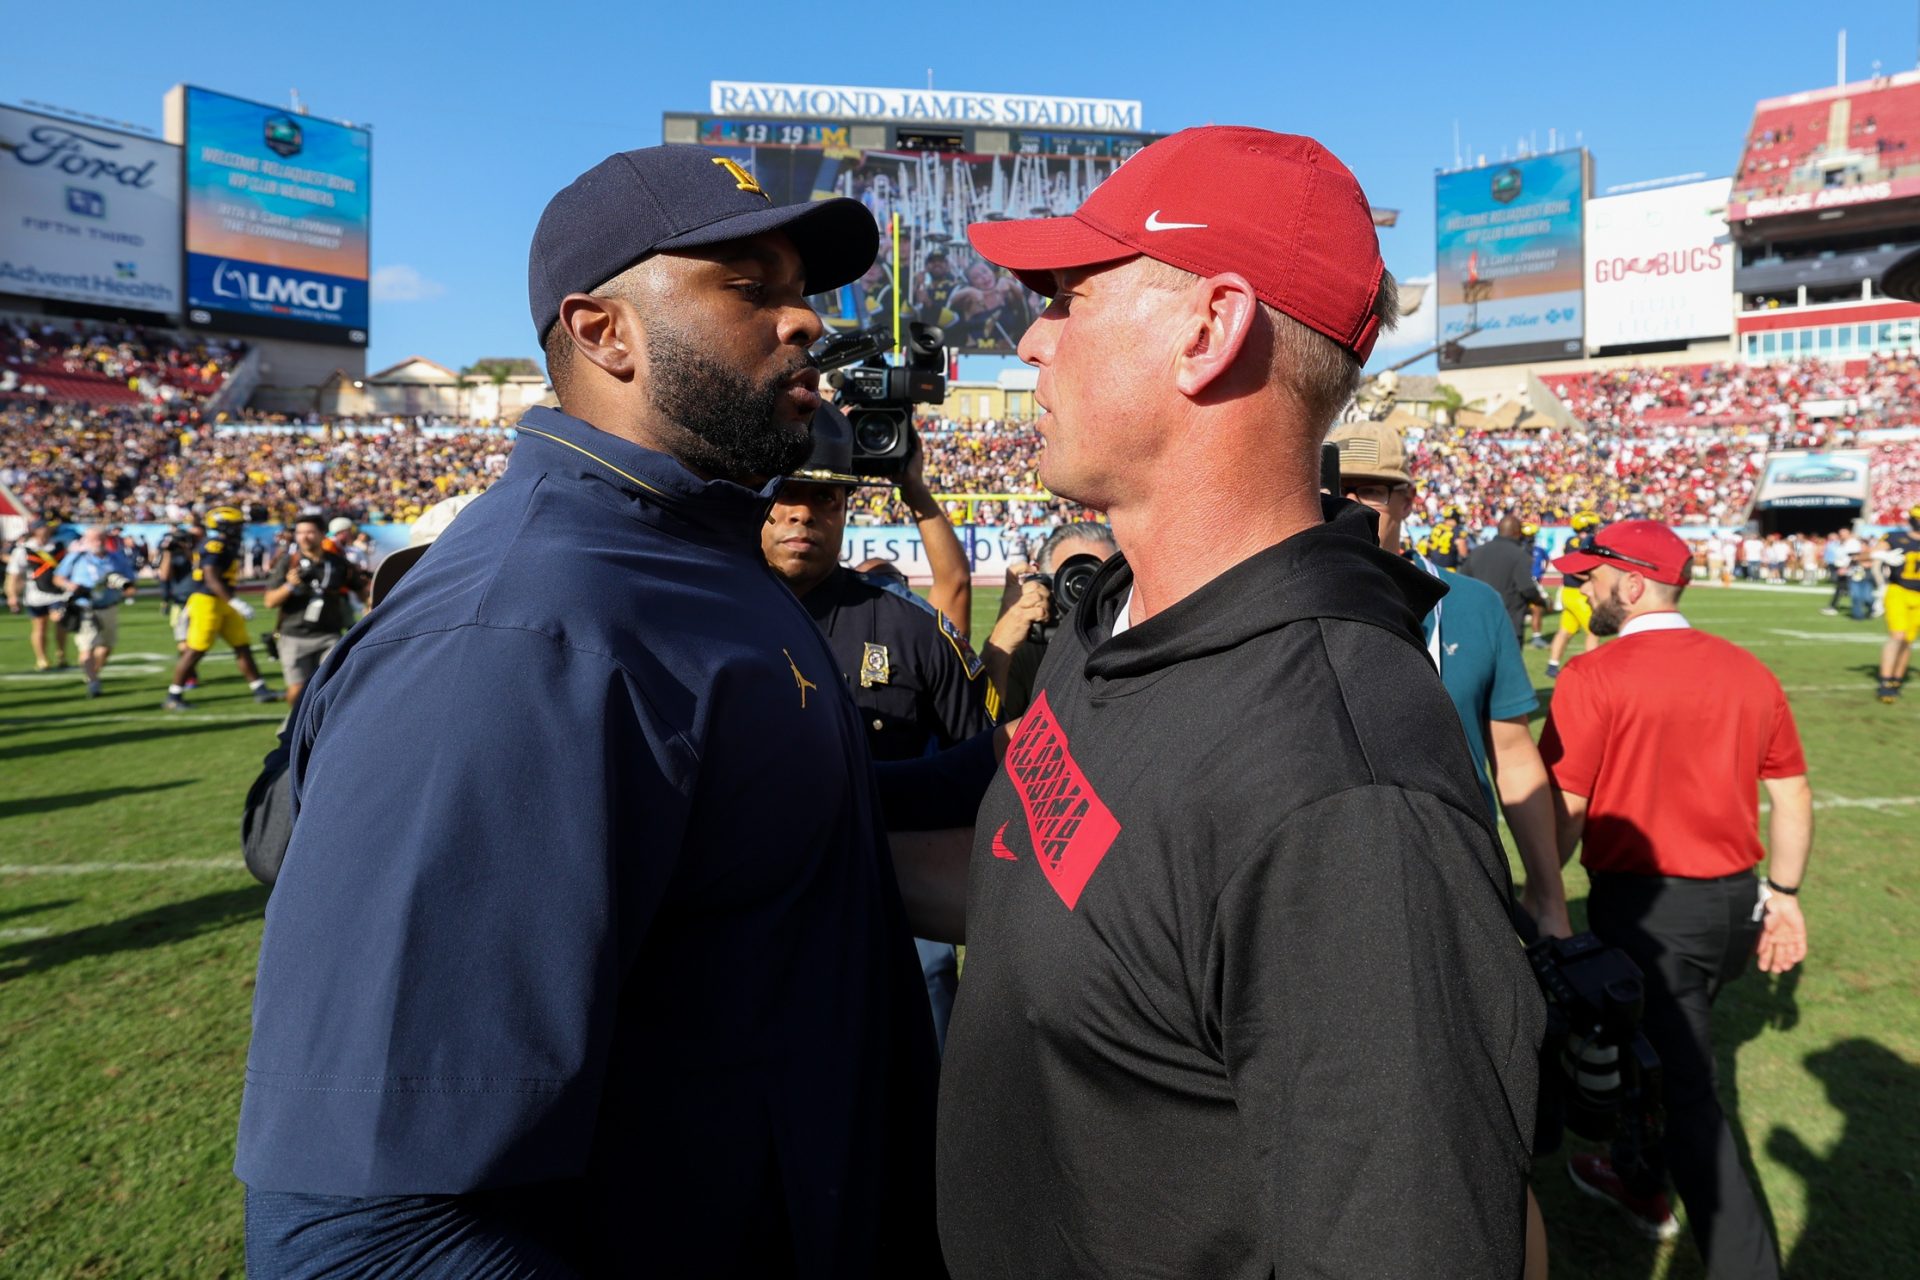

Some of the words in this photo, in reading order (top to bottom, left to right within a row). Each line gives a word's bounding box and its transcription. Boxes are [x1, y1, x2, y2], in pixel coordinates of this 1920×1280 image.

[720, 87, 885, 116] RAYMOND
[892, 94, 997, 121] JAMES
[1003, 99, 1137, 130] STADIUM
[745, 124, 768, 143] 13
[781, 126, 805, 145] 19
[821, 127, 848, 148] M
[12, 125, 158, 189] Ford
[1746, 193, 1812, 217] BRUCE
[1814, 181, 1892, 208] ARIANS
[22, 216, 81, 237] FIFTH
[87, 227, 145, 247] THIRD
[0, 261, 173, 301] AdventHealth
[1595, 258, 1625, 283] GO
[1656, 242, 1723, 276] BUCS
[248, 272, 343, 311] LMCU
